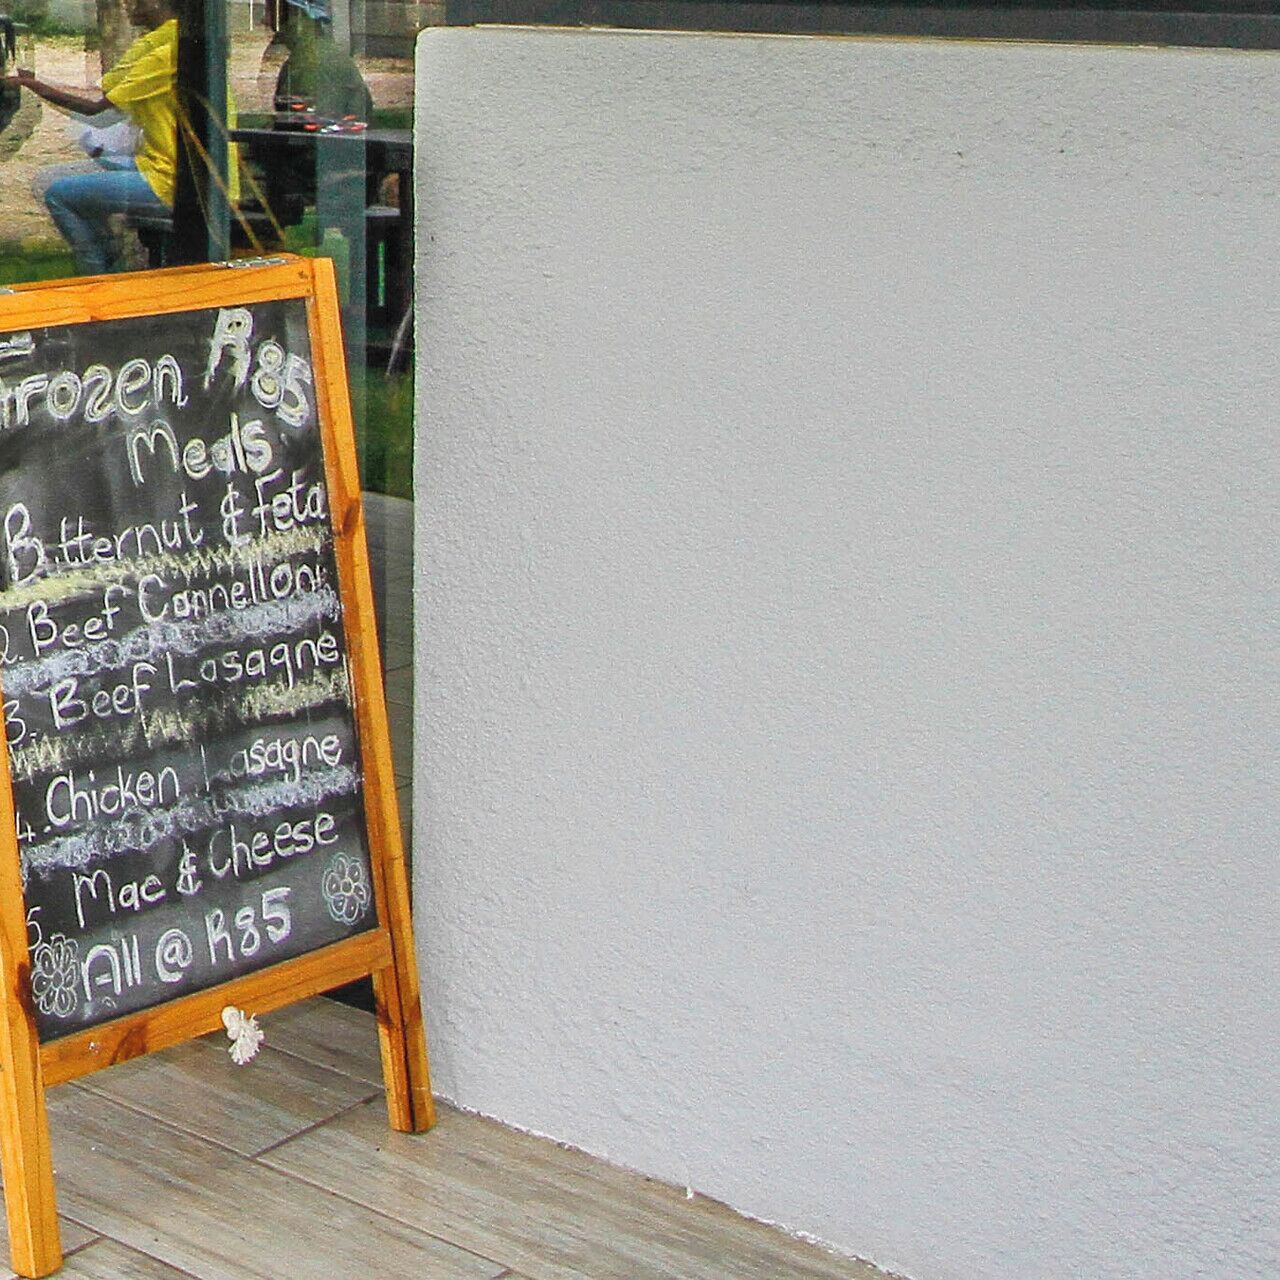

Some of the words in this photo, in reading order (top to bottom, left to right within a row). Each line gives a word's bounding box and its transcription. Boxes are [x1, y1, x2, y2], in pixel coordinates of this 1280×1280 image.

[126, 411, 273, 487] Meals
[4, 491, 204, 588] Btternut
[220, 482, 253, 547] &
[251, 467, 327, 539] Feta
[27, 583, 132, 657] Beef
[2, 699, 38, 746] 3.
[49, 662, 158, 730] Beef
[165, 634, 340, 695] Lasagne
[46, 765, 180, 827] Chicken
[71, 869, 166, 929] Mac
[176, 838, 202, 896] &
[209, 811, 340, 880] Cheese
[81, 933, 141, 1002] All
[155, 928, 193, 983] @
[206, 887, 294, 966] R85
